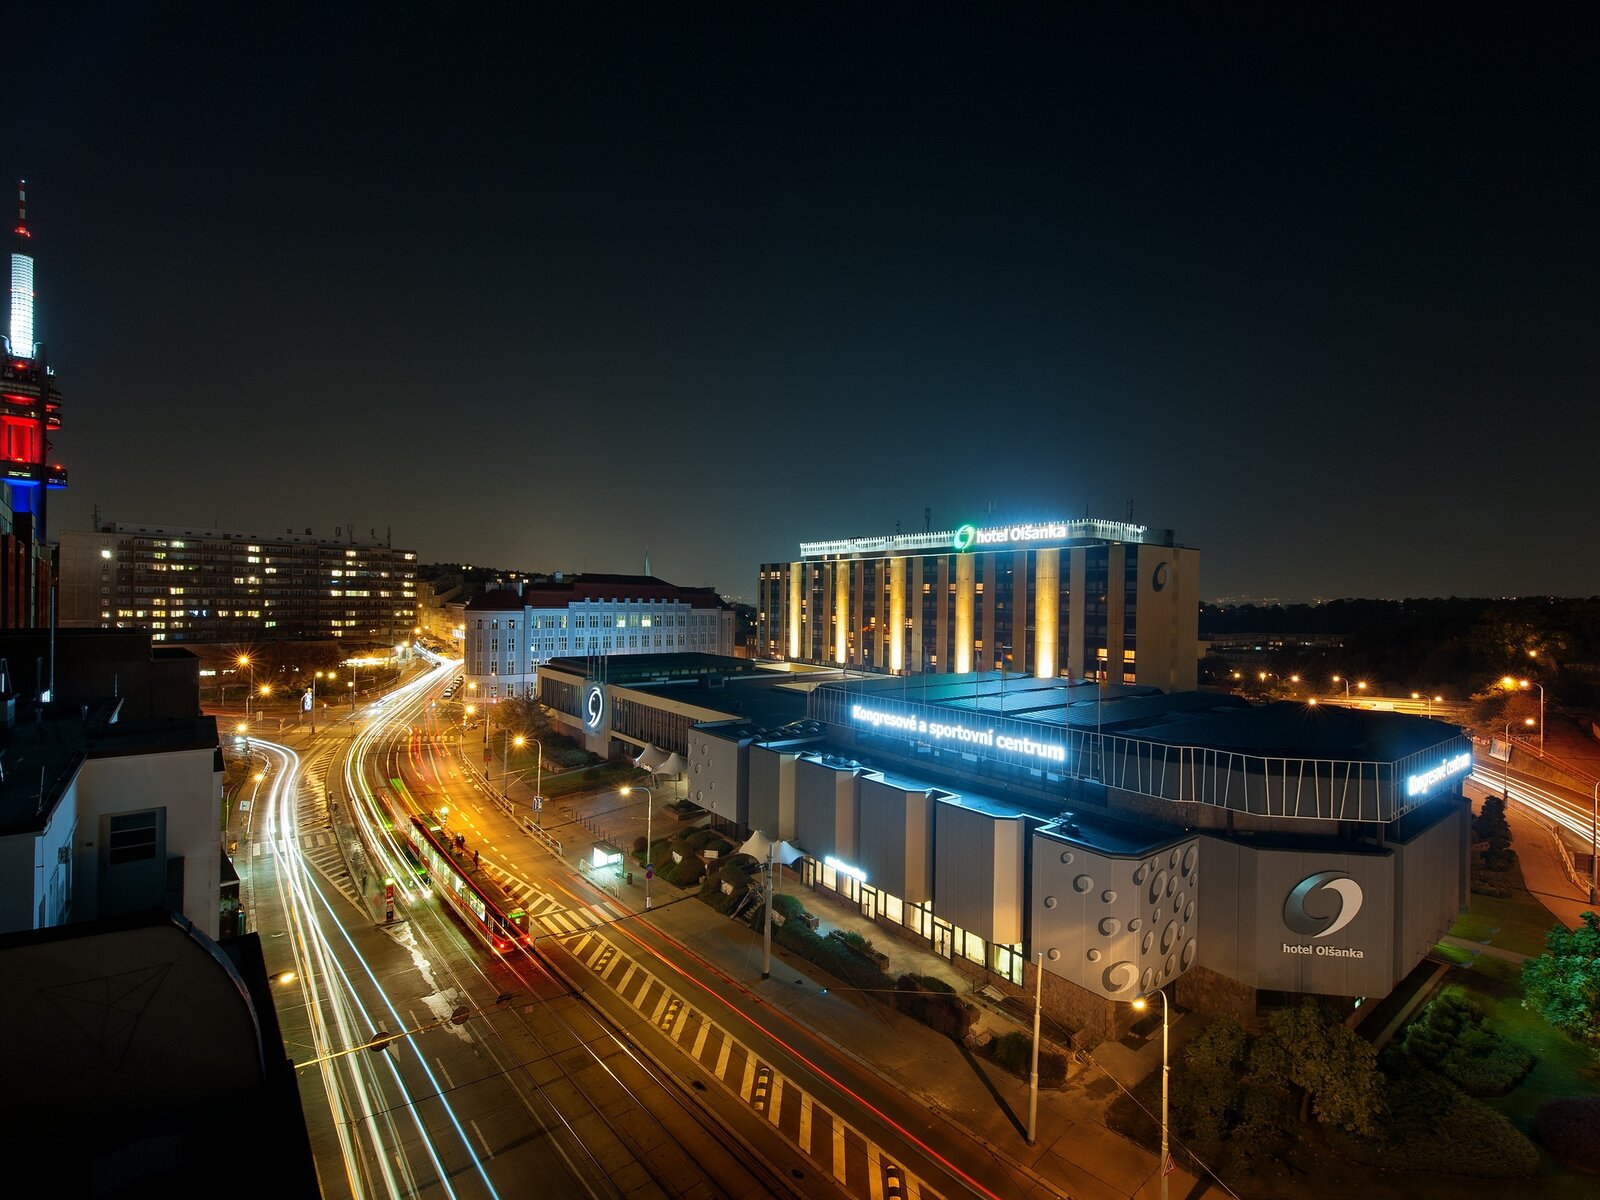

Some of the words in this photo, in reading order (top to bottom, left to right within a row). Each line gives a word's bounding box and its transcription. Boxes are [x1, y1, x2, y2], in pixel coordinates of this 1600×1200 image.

[976, 528, 1008, 545] hotel
[1010, 524, 1066, 542] Olšanka
[852, 705, 917, 731] Kongresové
[919, 719, 927, 732] a
[929, 722, 994, 746] sportovní
[996, 734, 1066, 762] centrum
[1282, 943, 1313, 955] hotel
[1315, 945, 1364, 959] Olšanka
